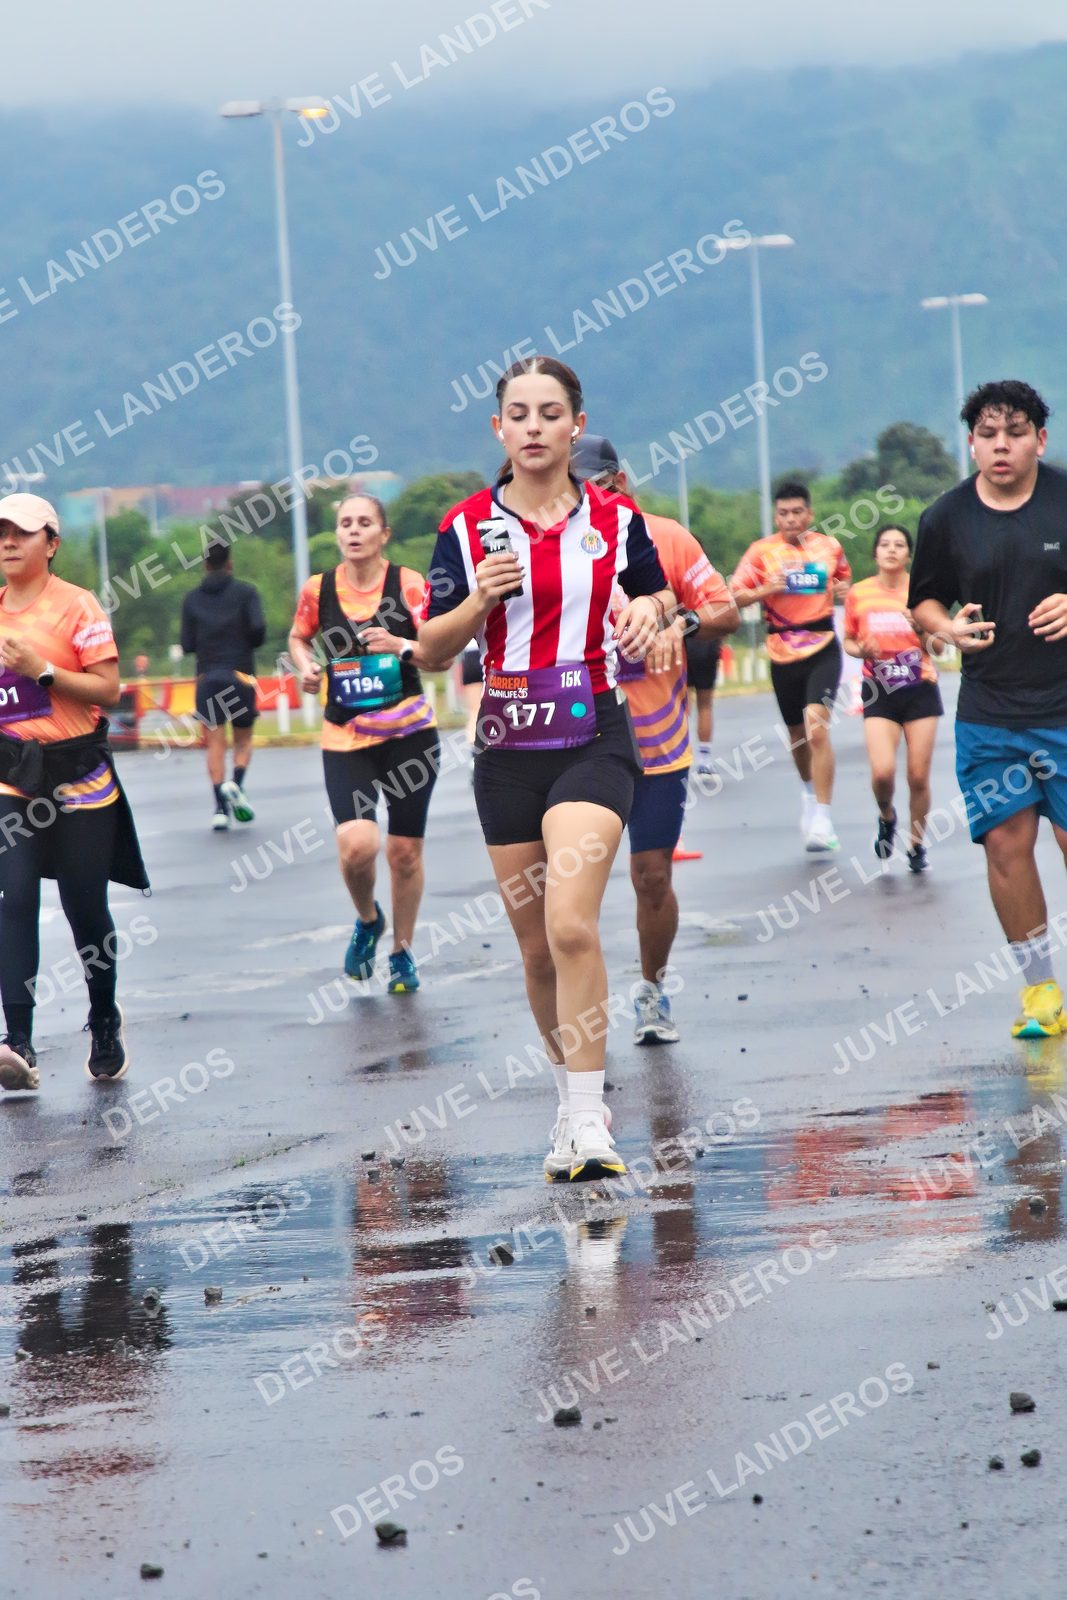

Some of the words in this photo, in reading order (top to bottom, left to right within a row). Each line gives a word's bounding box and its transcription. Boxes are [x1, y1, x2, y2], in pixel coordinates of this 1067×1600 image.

[342, 676, 384, 694] 1194
[561, 670, 582, 688] 15K
[506, 702, 556, 727] 177
